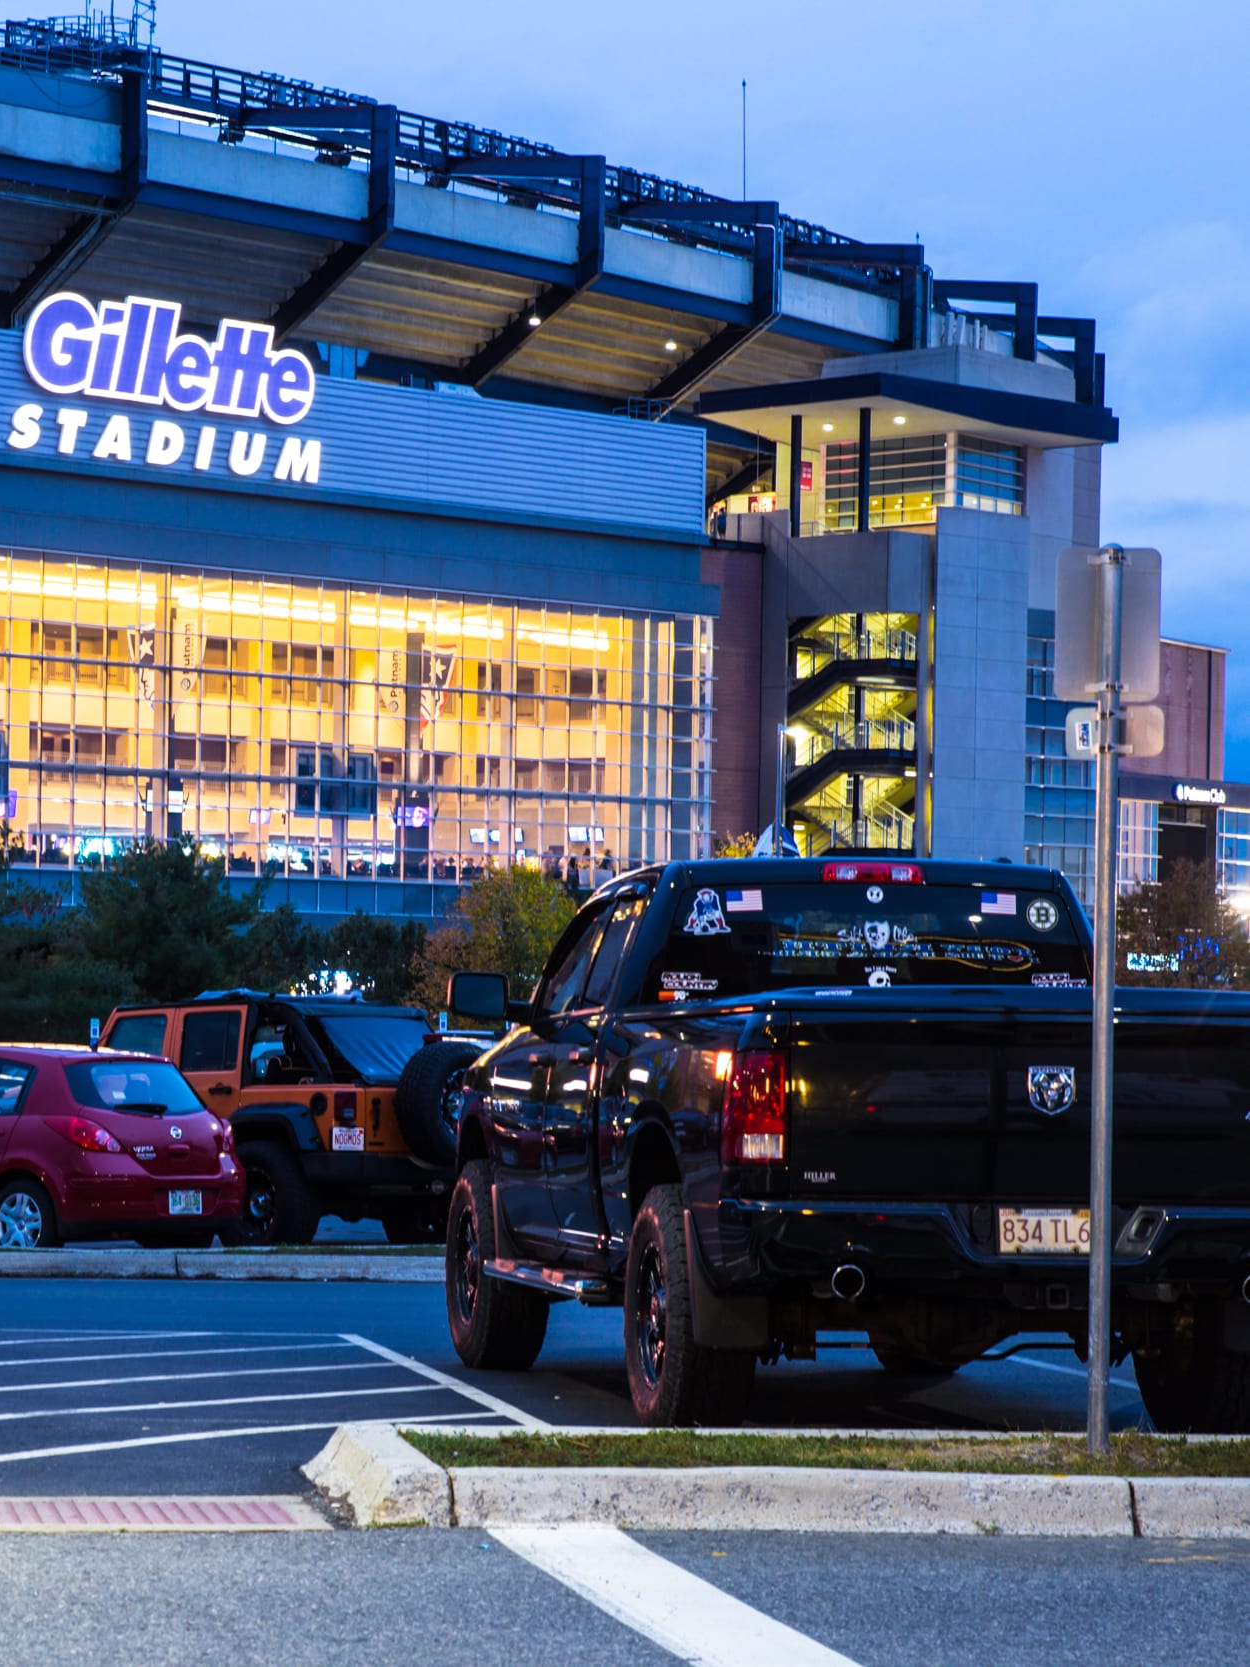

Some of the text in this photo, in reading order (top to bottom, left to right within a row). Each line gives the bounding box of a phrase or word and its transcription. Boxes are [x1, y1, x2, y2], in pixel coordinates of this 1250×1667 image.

[23, 292, 316, 425] Gillette
[6, 403, 322, 484] STADIUM
[182, 623, 191, 675] utnam
[664, 980, 717, 989] COUNTRY
[803, 1171, 837, 1180] HILLER
[1003, 1219, 1090, 1244] 834 TL6
